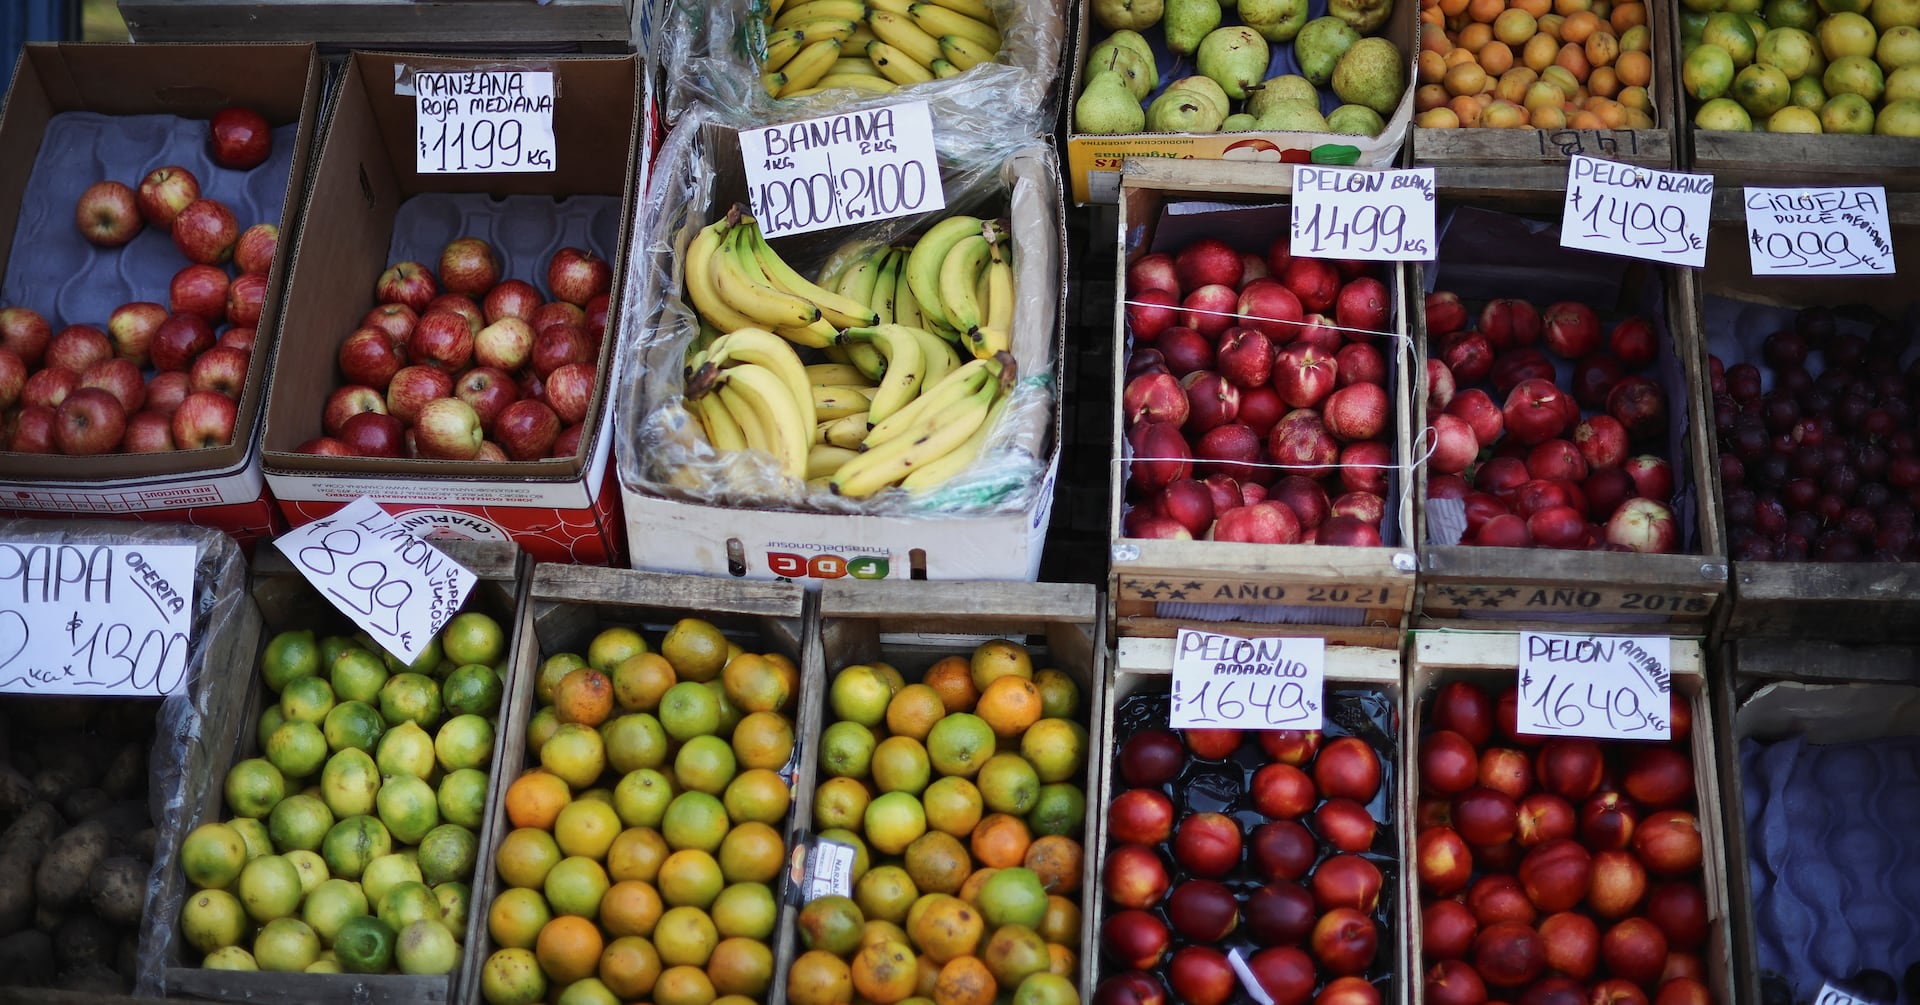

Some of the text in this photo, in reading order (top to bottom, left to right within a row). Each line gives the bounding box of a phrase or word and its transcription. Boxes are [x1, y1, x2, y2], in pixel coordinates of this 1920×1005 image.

[418, 72, 523, 97] MANZANA
[764, 109, 895, 156] BANANA
[527, 149, 551, 169] KG
[1657, 174, 1713, 194] BLANCO
[1403, 239, 1428, 255] KG
[144, 489, 191, 498] DELICIOUS
[164, 496, 216, 505] ELEGIDO
[765, 541, 890, 555] FrutasDelConosur
[0, 544, 113, 604] PAPA
[125, 551, 185, 615] OFERTA
[1213, 582, 1390, 605] AÑO 2021
[1527, 587, 1600, 607] AÑO
[1647, 712, 1670, 731] KG
[832, 859, 842, 895] NARANJ
